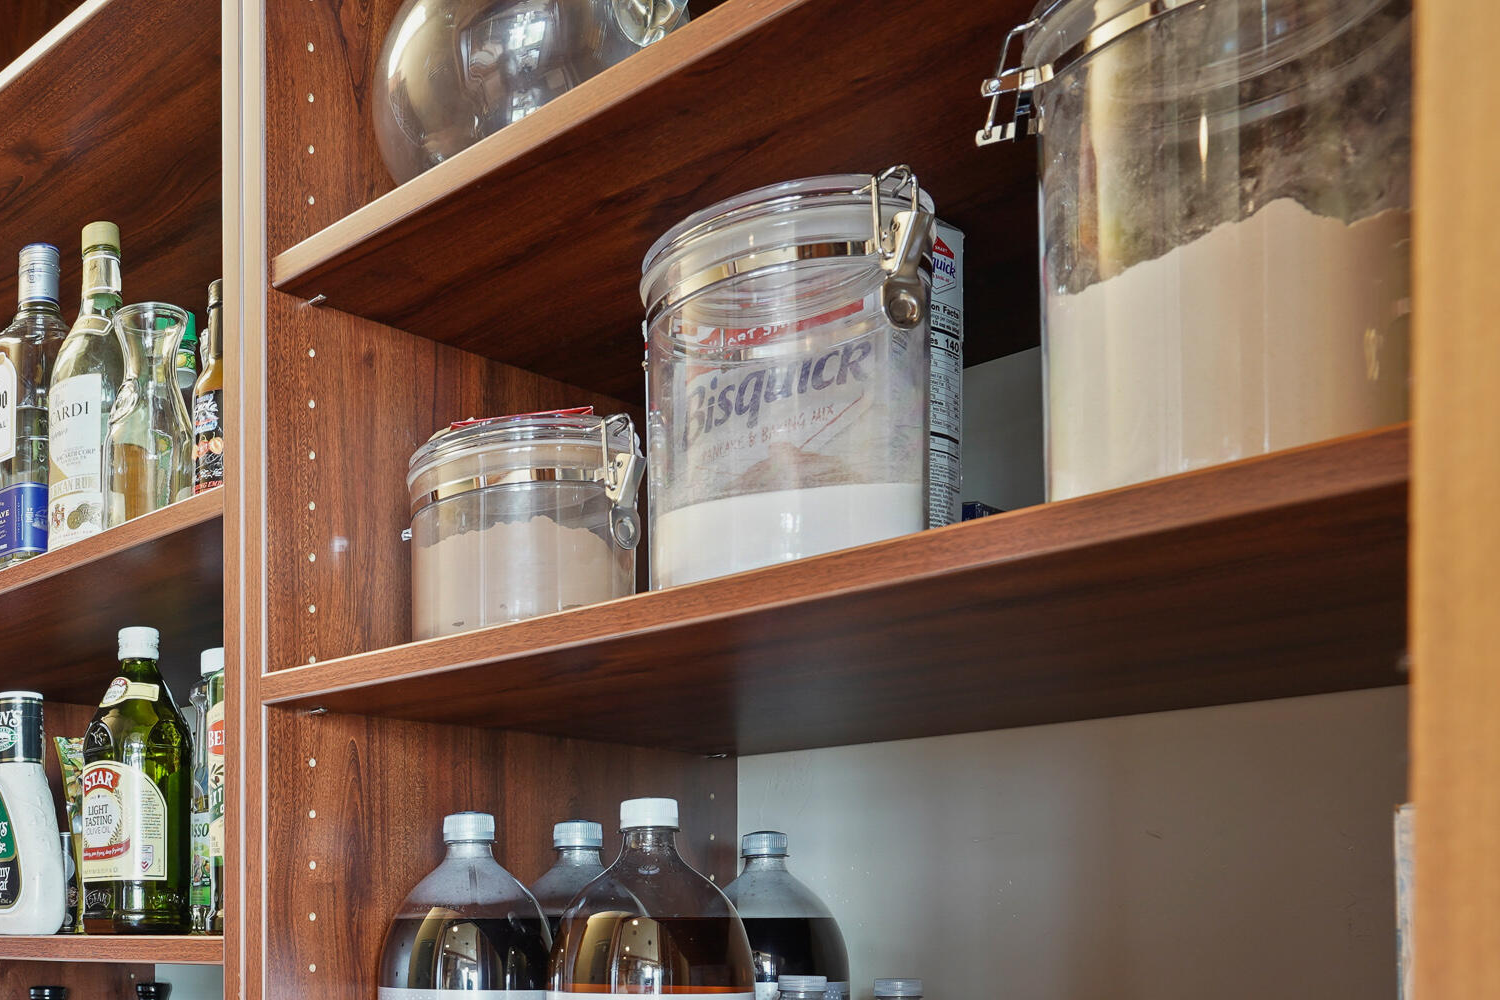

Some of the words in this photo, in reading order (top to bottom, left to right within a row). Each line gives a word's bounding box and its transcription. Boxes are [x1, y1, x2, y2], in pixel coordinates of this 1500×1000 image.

[931, 256, 956, 279] quick
[942, 305, 960, 320] Facts
[944, 338, 960, 353] 140
[50, 400, 89, 427] CARDI
[84, 770, 114, 791] STAR
[88, 803, 109, 816] LIGHT
[85, 814, 113, 827] TASTING
[86, 826, 101, 836] OLIVE
[102, 825, 111, 834] OIL
